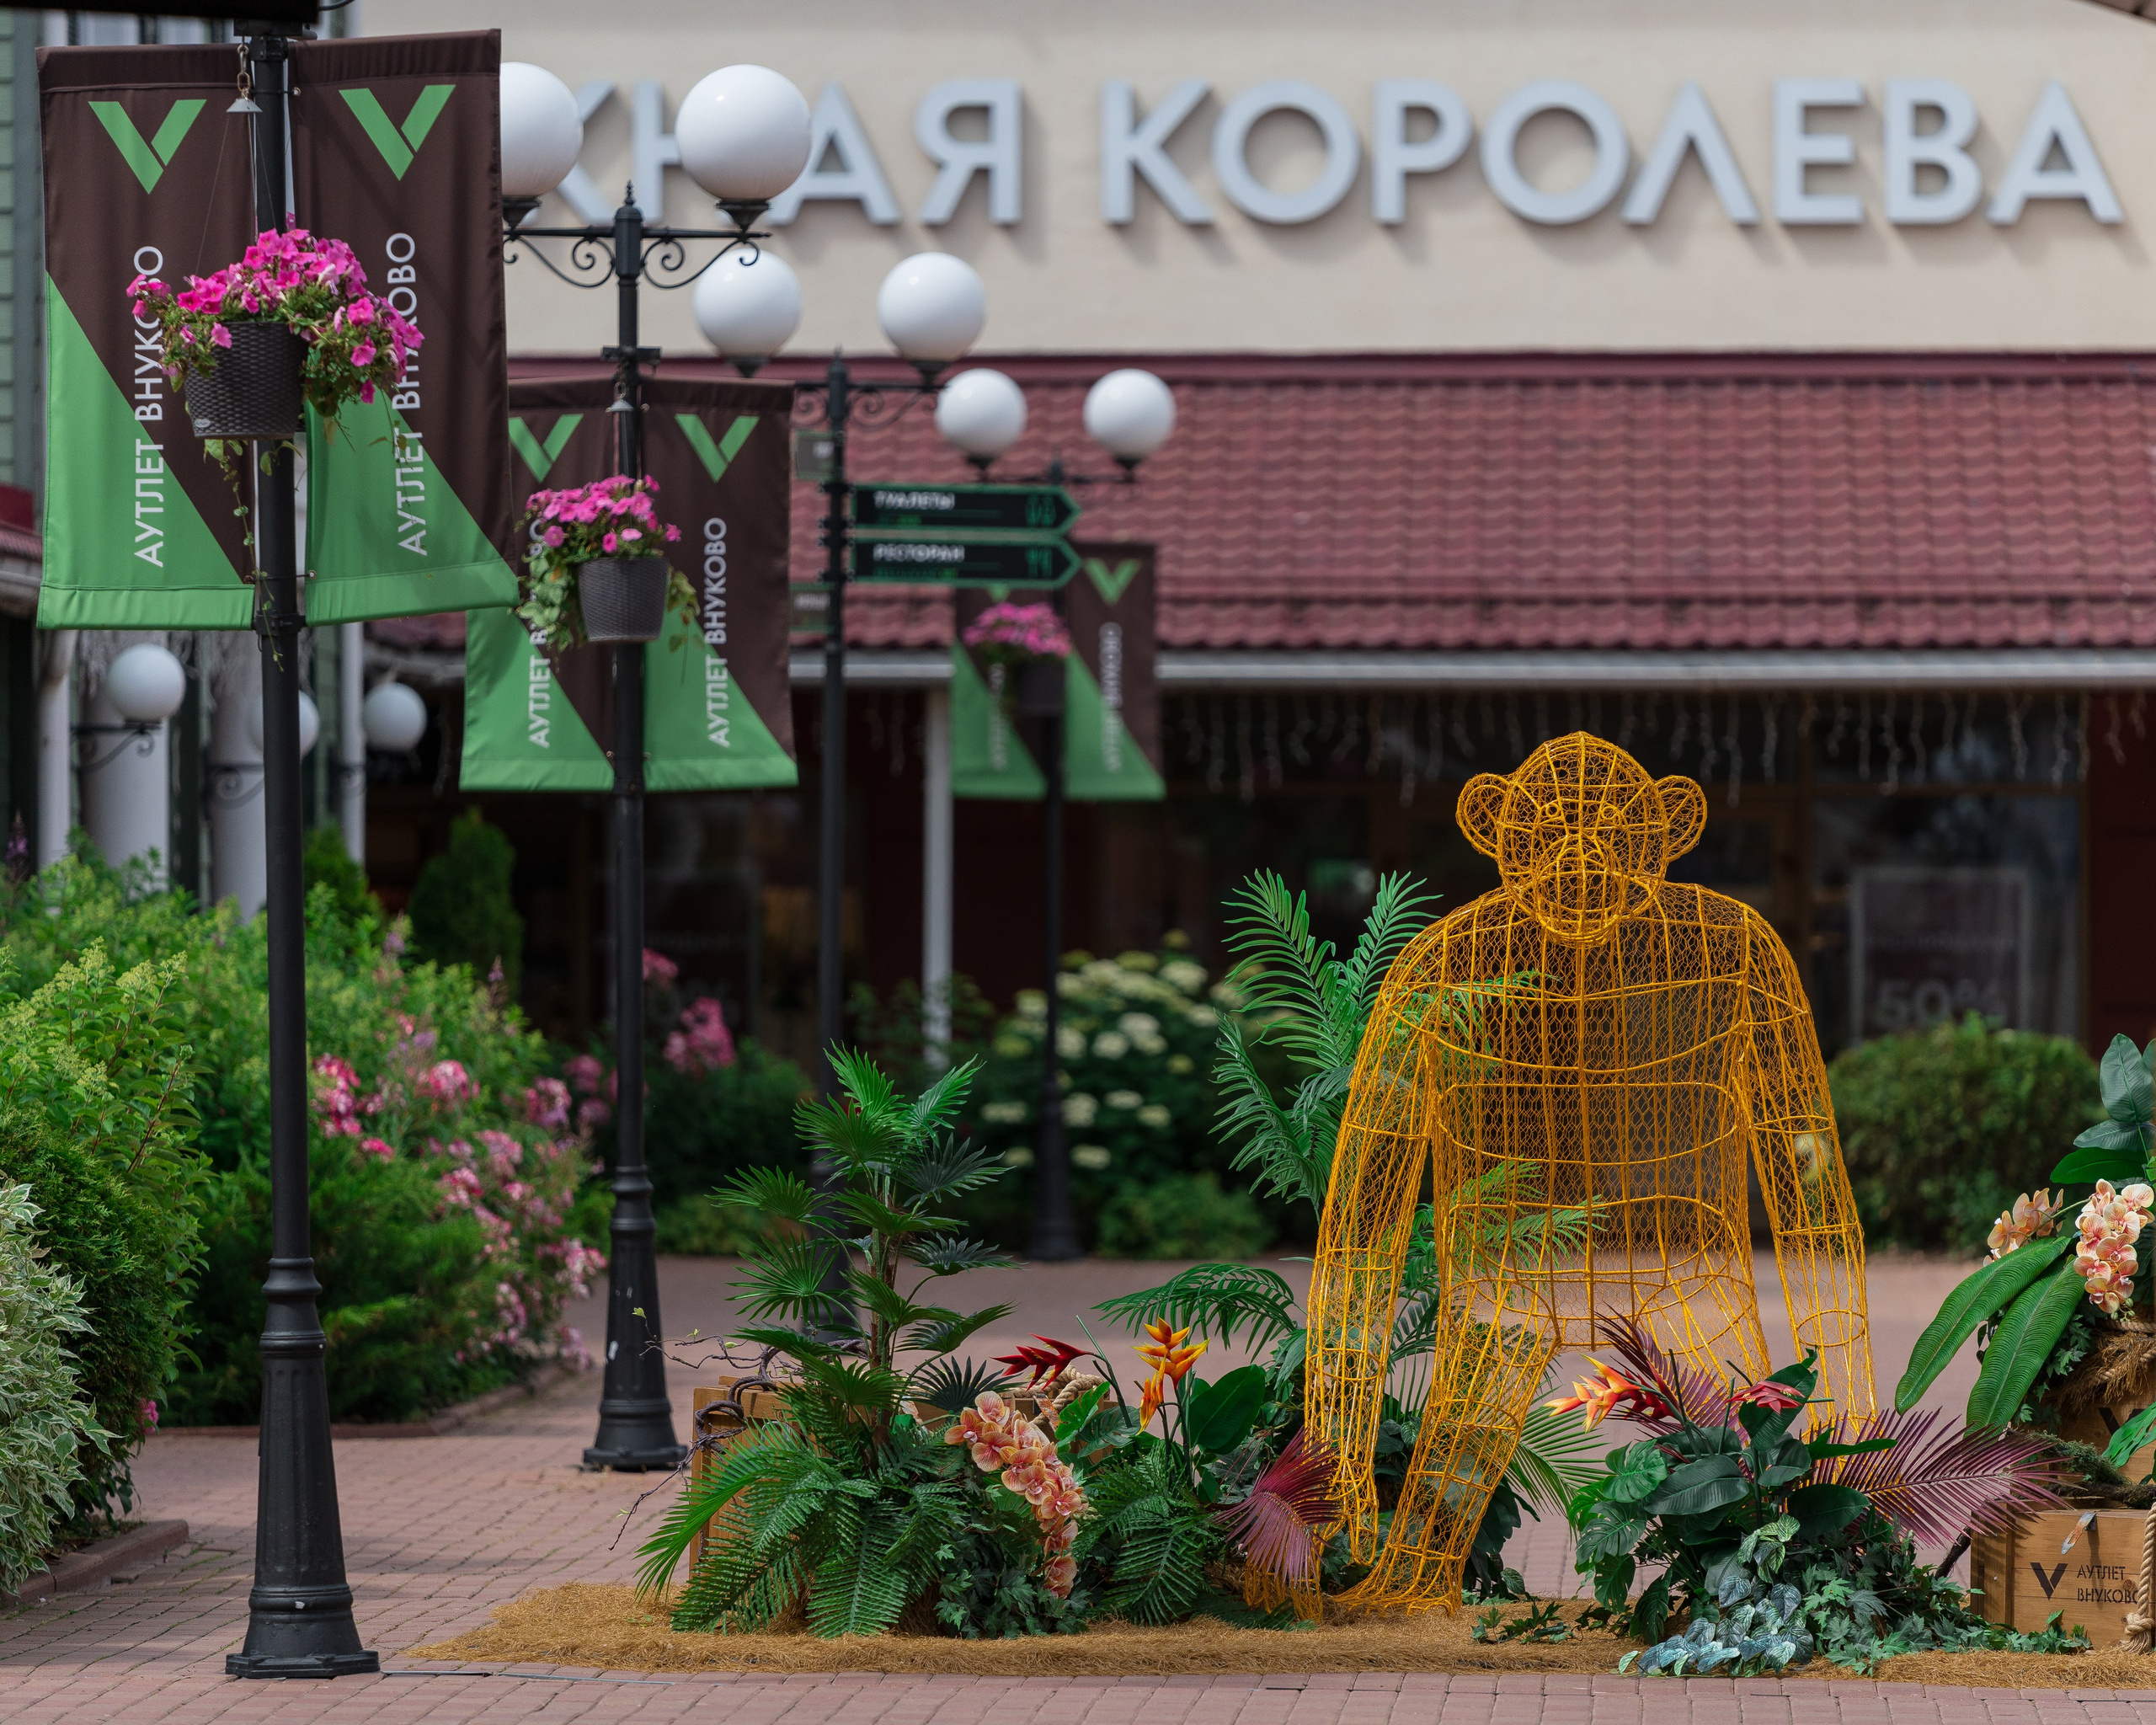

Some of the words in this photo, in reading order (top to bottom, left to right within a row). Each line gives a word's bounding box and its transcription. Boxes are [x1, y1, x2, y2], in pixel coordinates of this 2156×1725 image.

[1102, 79, 2125, 226] КОРОЛЕВА
[134, 438, 164, 569] АУТЛЕТ
[394, 427, 428, 557] АУТЛЕТ
[703, 516, 728, 645] ВНУКОВО
[528, 654, 552, 749] АУТЛЕТ
[707, 654, 730, 748] АУТЛЕТ
[2077, 1564, 2126, 1581] АУТЛЕТ
